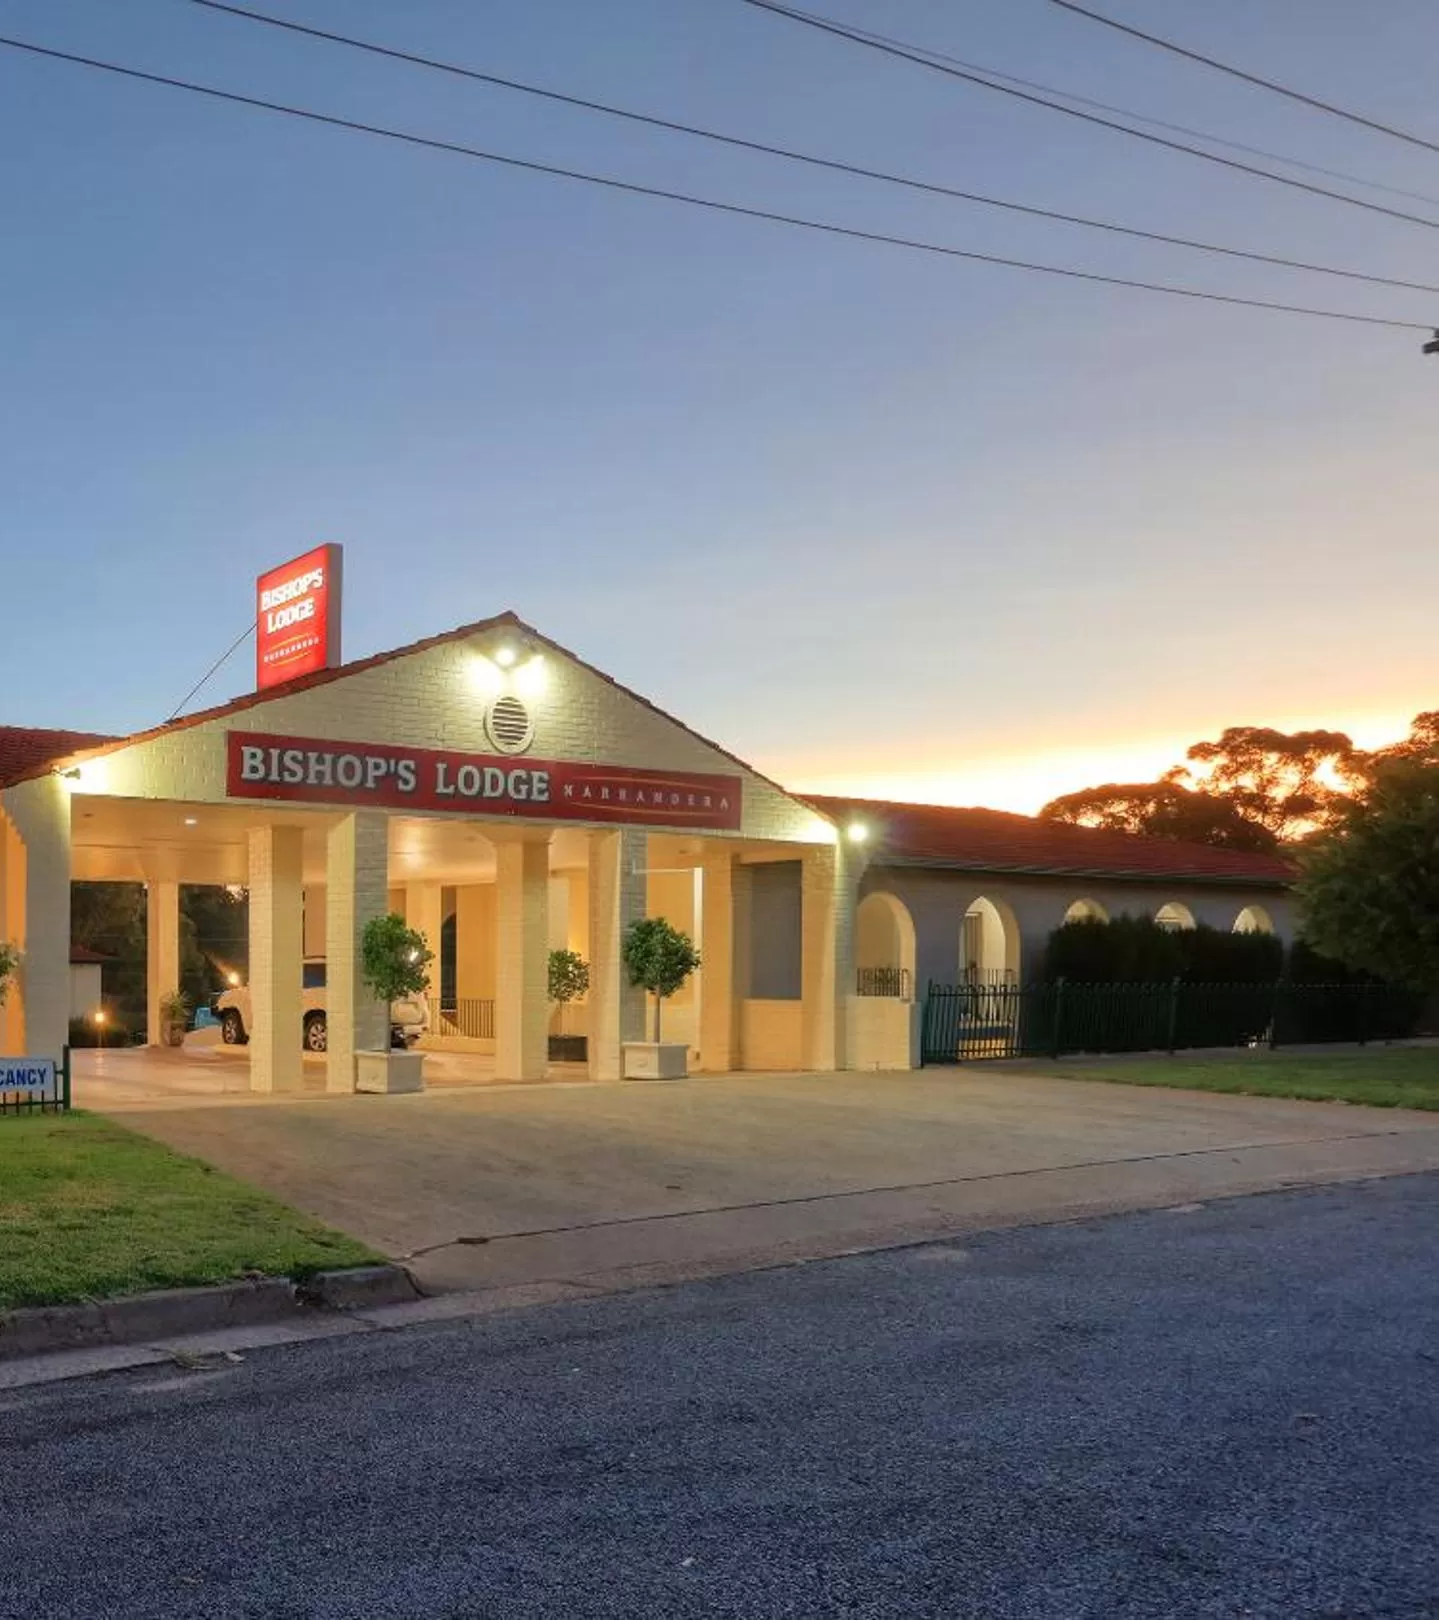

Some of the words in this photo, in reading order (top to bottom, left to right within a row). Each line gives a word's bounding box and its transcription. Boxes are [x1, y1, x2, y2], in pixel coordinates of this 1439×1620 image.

[266, 598, 315, 634] LODGE
[241, 746, 416, 792] BISHOP'S
[435, 763, 550, 802] LODGE
